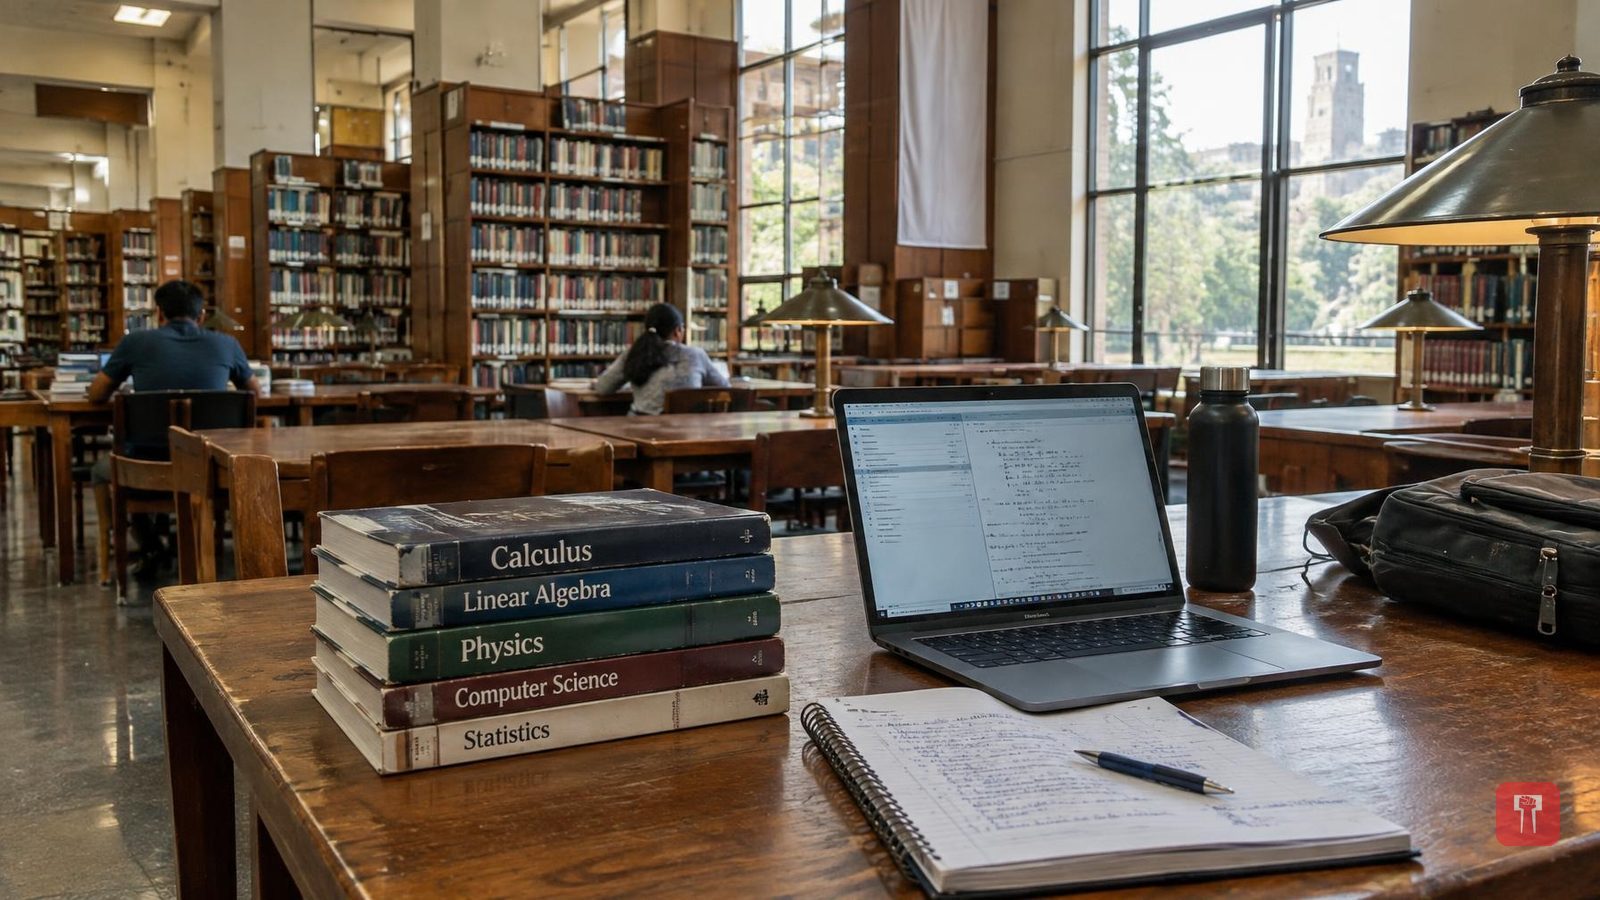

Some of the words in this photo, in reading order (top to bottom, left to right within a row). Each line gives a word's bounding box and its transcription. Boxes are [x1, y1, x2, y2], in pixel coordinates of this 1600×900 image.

[491, 540, 592, 570] Calculus
[464, 590, 527, 612] Linear
[535, 580, 611, 608] Algebra
[461, 633, 544, 663] Physics
[455, 682, 548, 708] Computer
[553, 672, 618, 694] Science
[463, 722, 550, 751] Statistics
